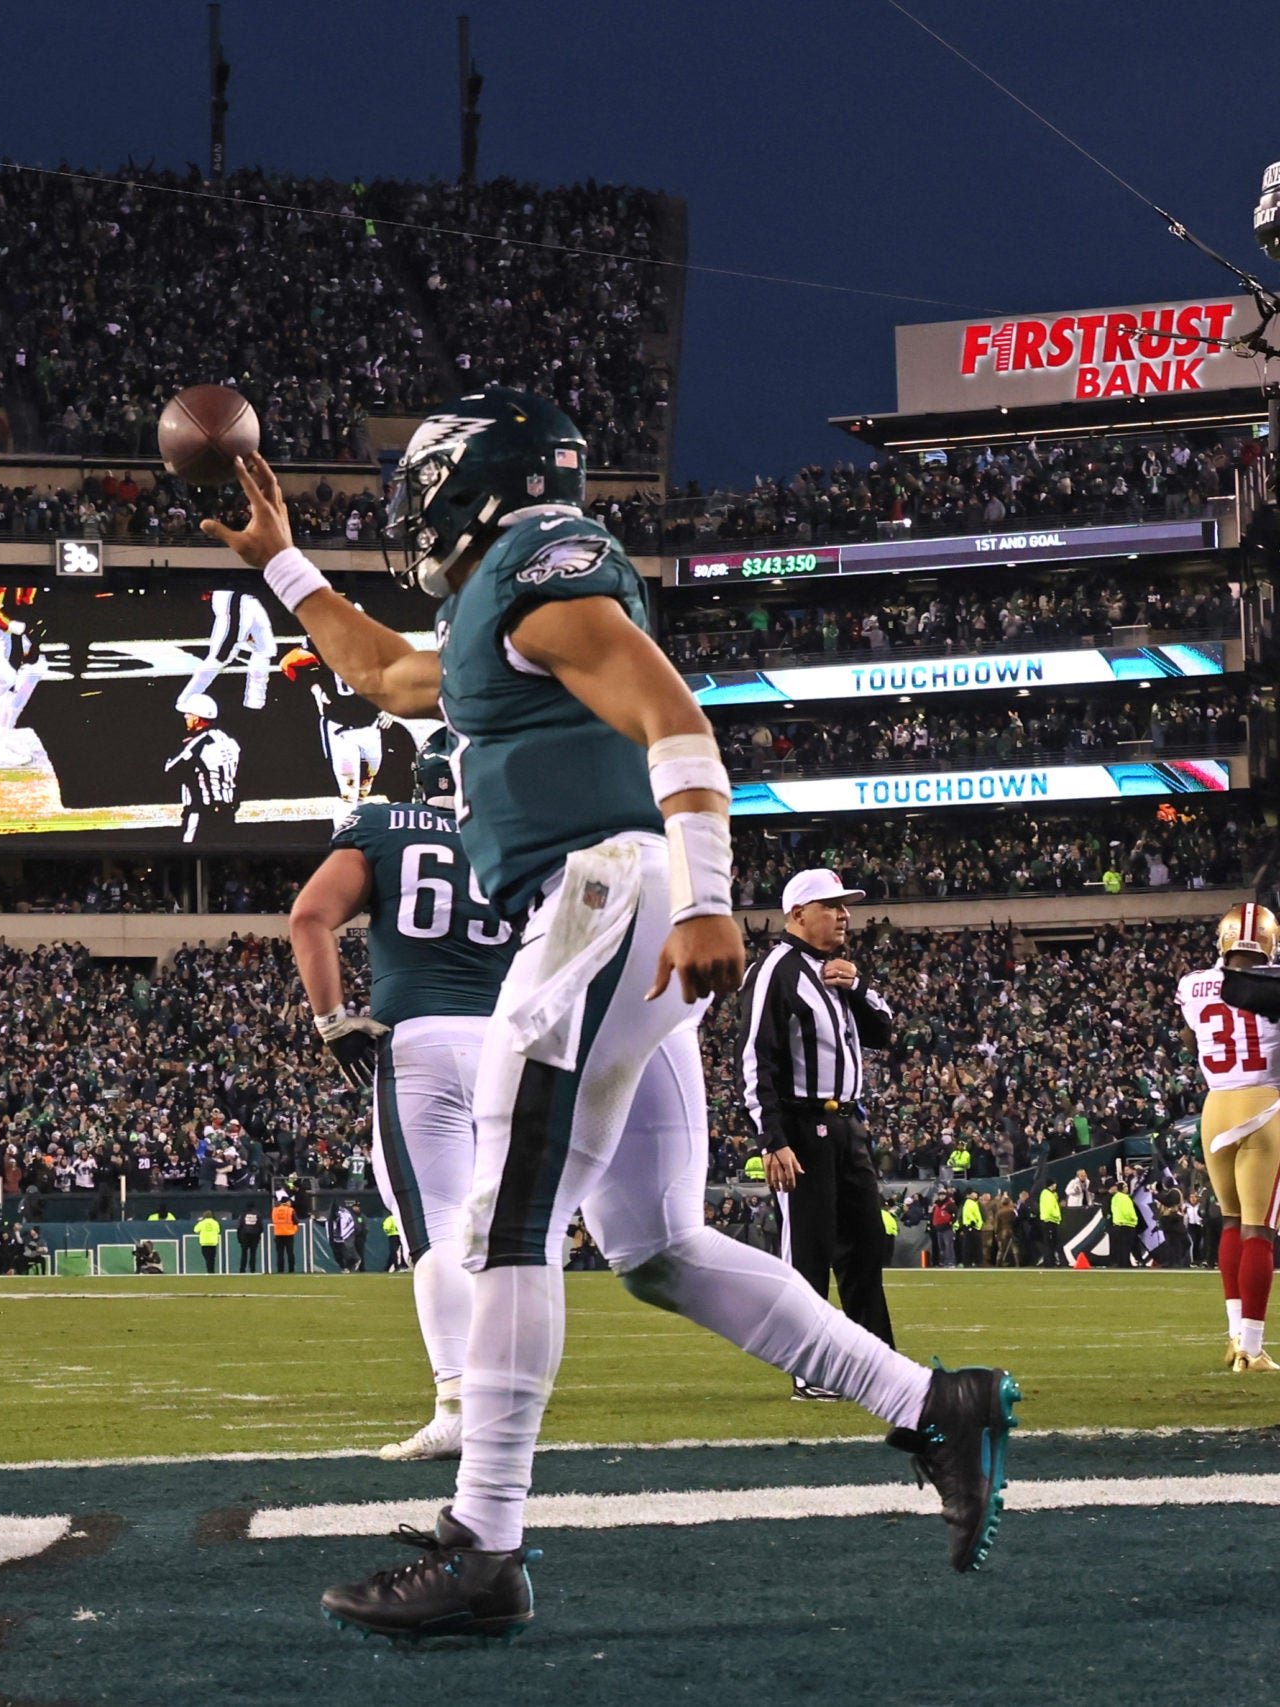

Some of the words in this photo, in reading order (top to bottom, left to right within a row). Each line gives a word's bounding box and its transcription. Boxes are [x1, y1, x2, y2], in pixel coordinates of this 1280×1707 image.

[1076, 357, 1204, 399] BANK
[975, 538, 997, 551] 1ST
[999, 536, 1026, 549] AND
[1029, 534, 1067, 548] GOAL.
[742, 554, 817, 577] $343,350
[851, 658, 1043, 691] TOUCHDOWN
[855, 772, 1048, 804] TOUCHDOWN
[1200, 1003, 1267, 1074] 31
